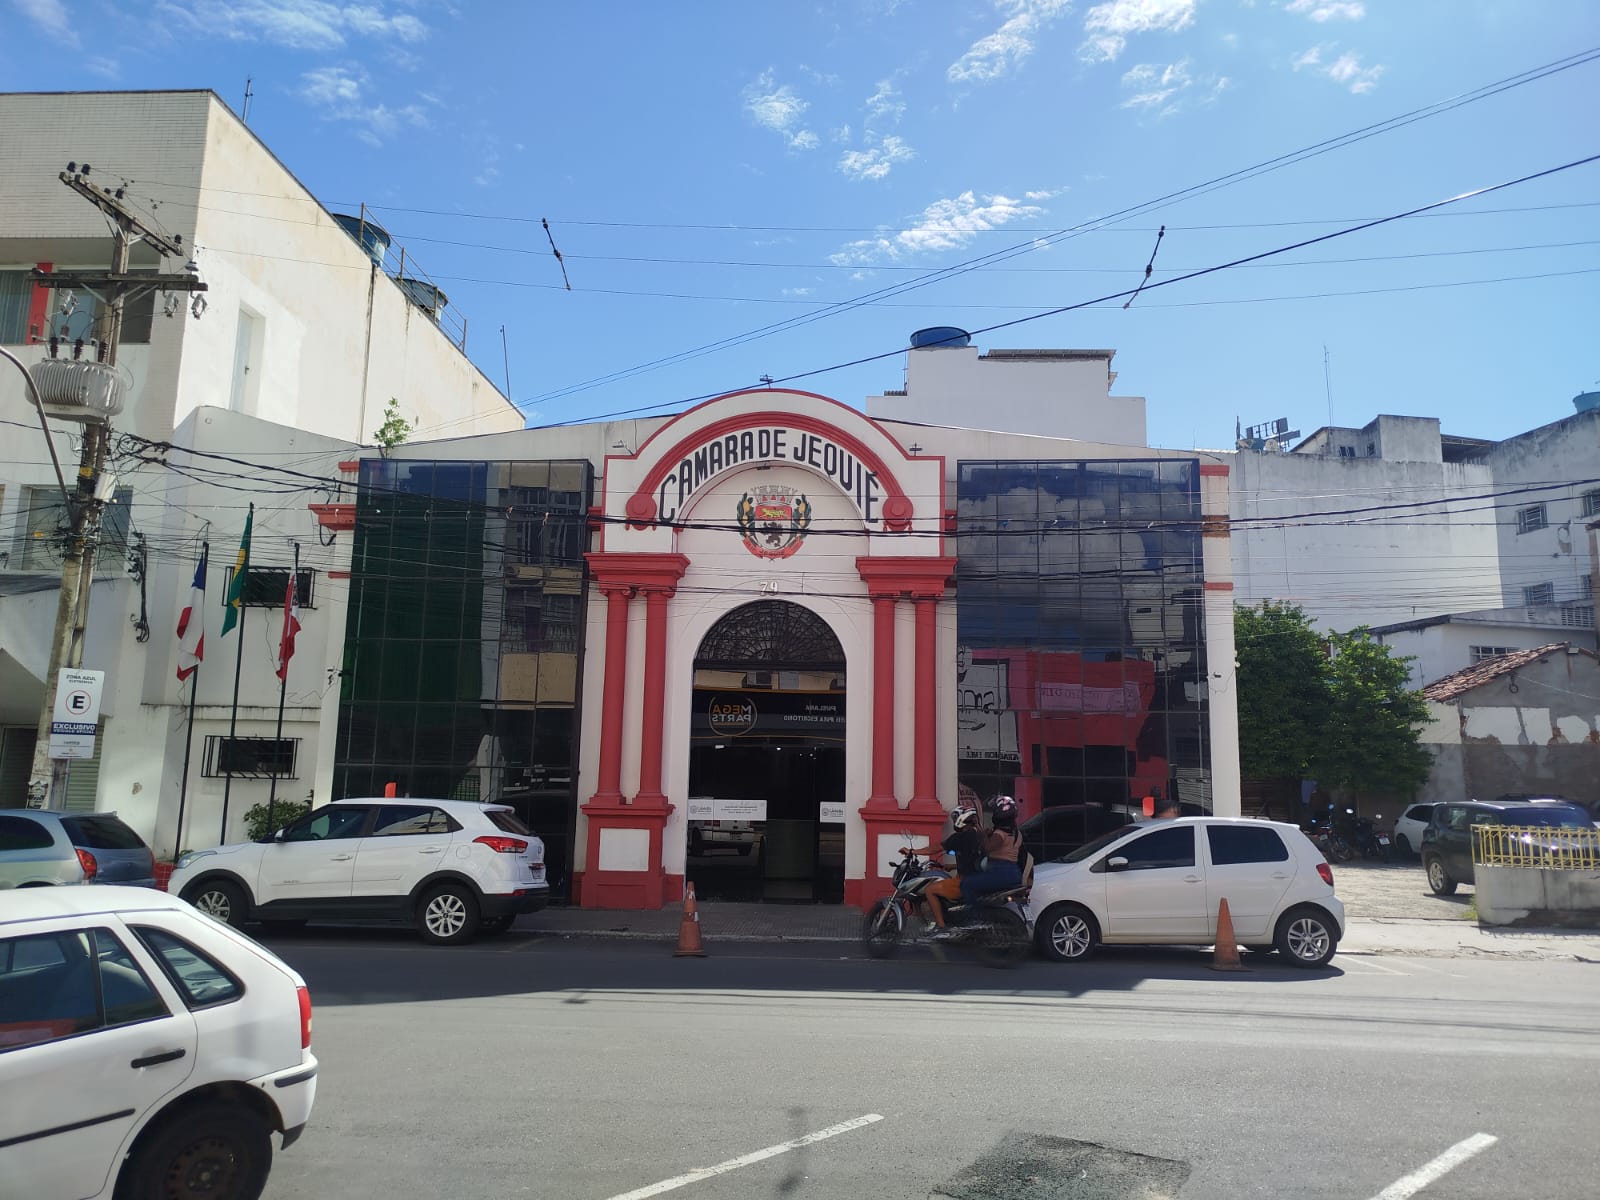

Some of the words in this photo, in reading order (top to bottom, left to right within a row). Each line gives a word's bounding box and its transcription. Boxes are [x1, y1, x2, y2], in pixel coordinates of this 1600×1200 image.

[758, 429, 787, 459] DE
[760, 581, 778, 596] 79
[72, 695, 85, 709] E
[53, 723, 96, 731] EXCLUSIVO
